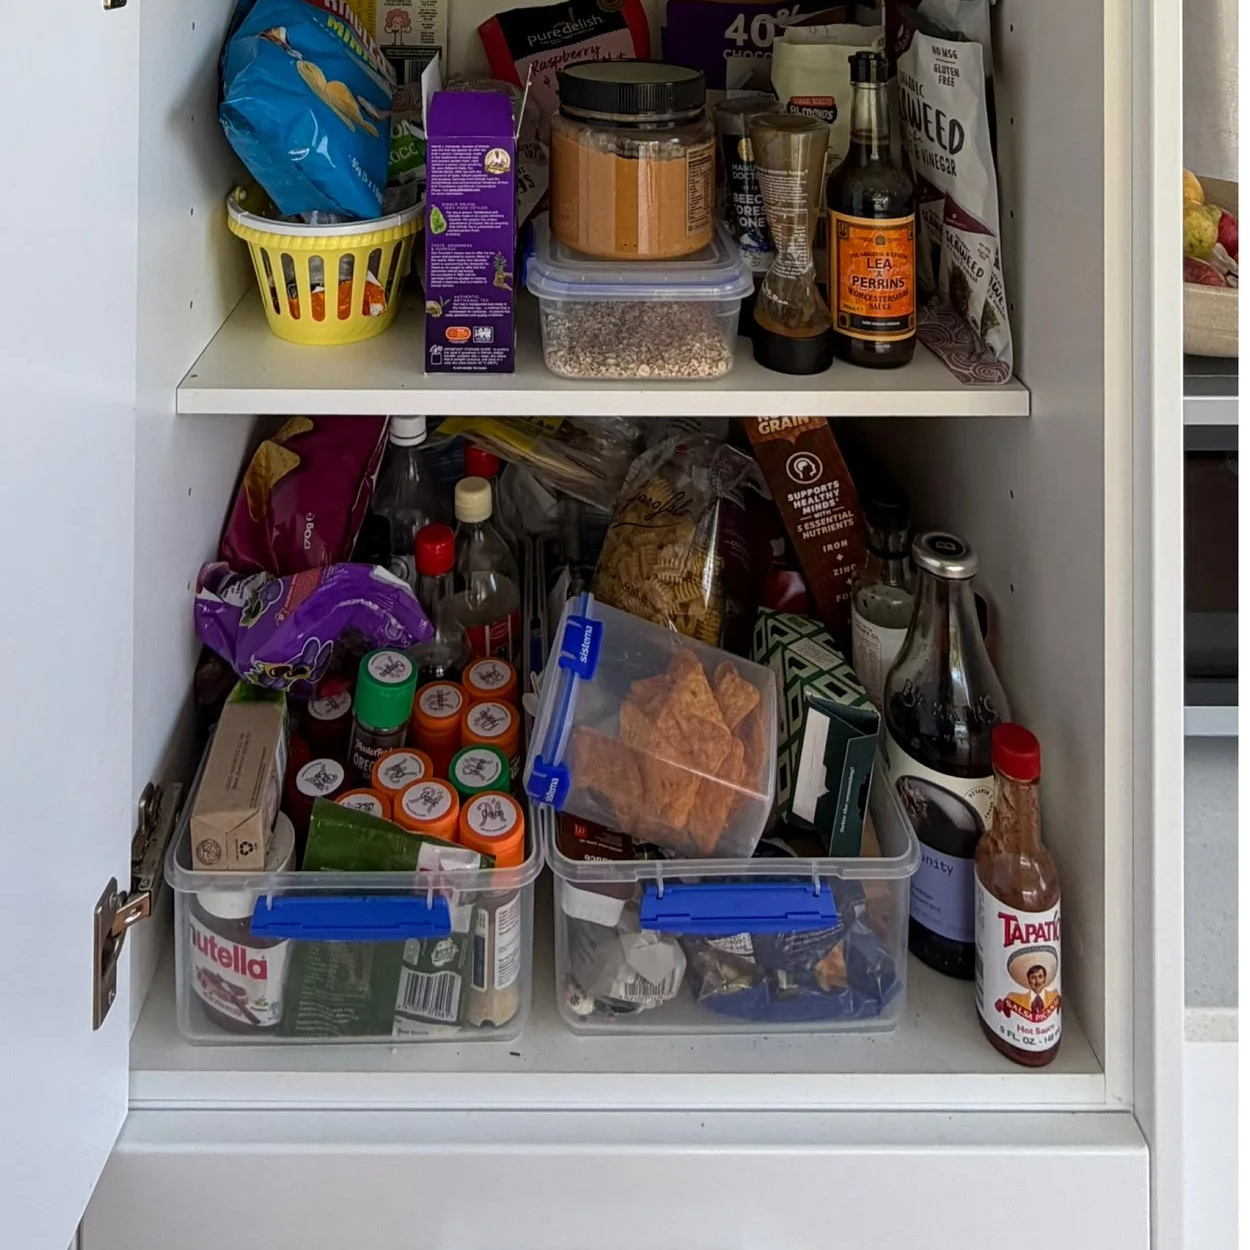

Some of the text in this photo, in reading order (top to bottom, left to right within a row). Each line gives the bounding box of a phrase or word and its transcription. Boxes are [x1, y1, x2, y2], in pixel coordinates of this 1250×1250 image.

[527, 15, 603, 46] pure delish
[932, 45, 958, 60] NO MSG
[531, 45, 601, 76] Raspberry
[933, 63, 960, 78] GLUTEN
[938, 75, 956, 88] FREE
[790, 106, 834, 120] ALMONDS
[921, 149, 957, 177] VINEGAR
[866, 258, 892, 270] LEA
[852, 275, 905, 290] PERRINS
[758, 416, 811, 435] GRAIN
[786, 480, 840, 501] SUPPORTS
[793, 490, 840, 509] HEALTHY
[804, 510, 855, 531] ESSENTIAL
[814, 509, 832, 519] WITH
[802, 518, 855, 540] NUTRIENTS
[822, 539, 848, 553] IRON
[580, 625, 593, 664] sistema
[1016, 1023, 1056, 1035] Hot Sauce
[1022, 1036, 1037, 1045] OZ.
